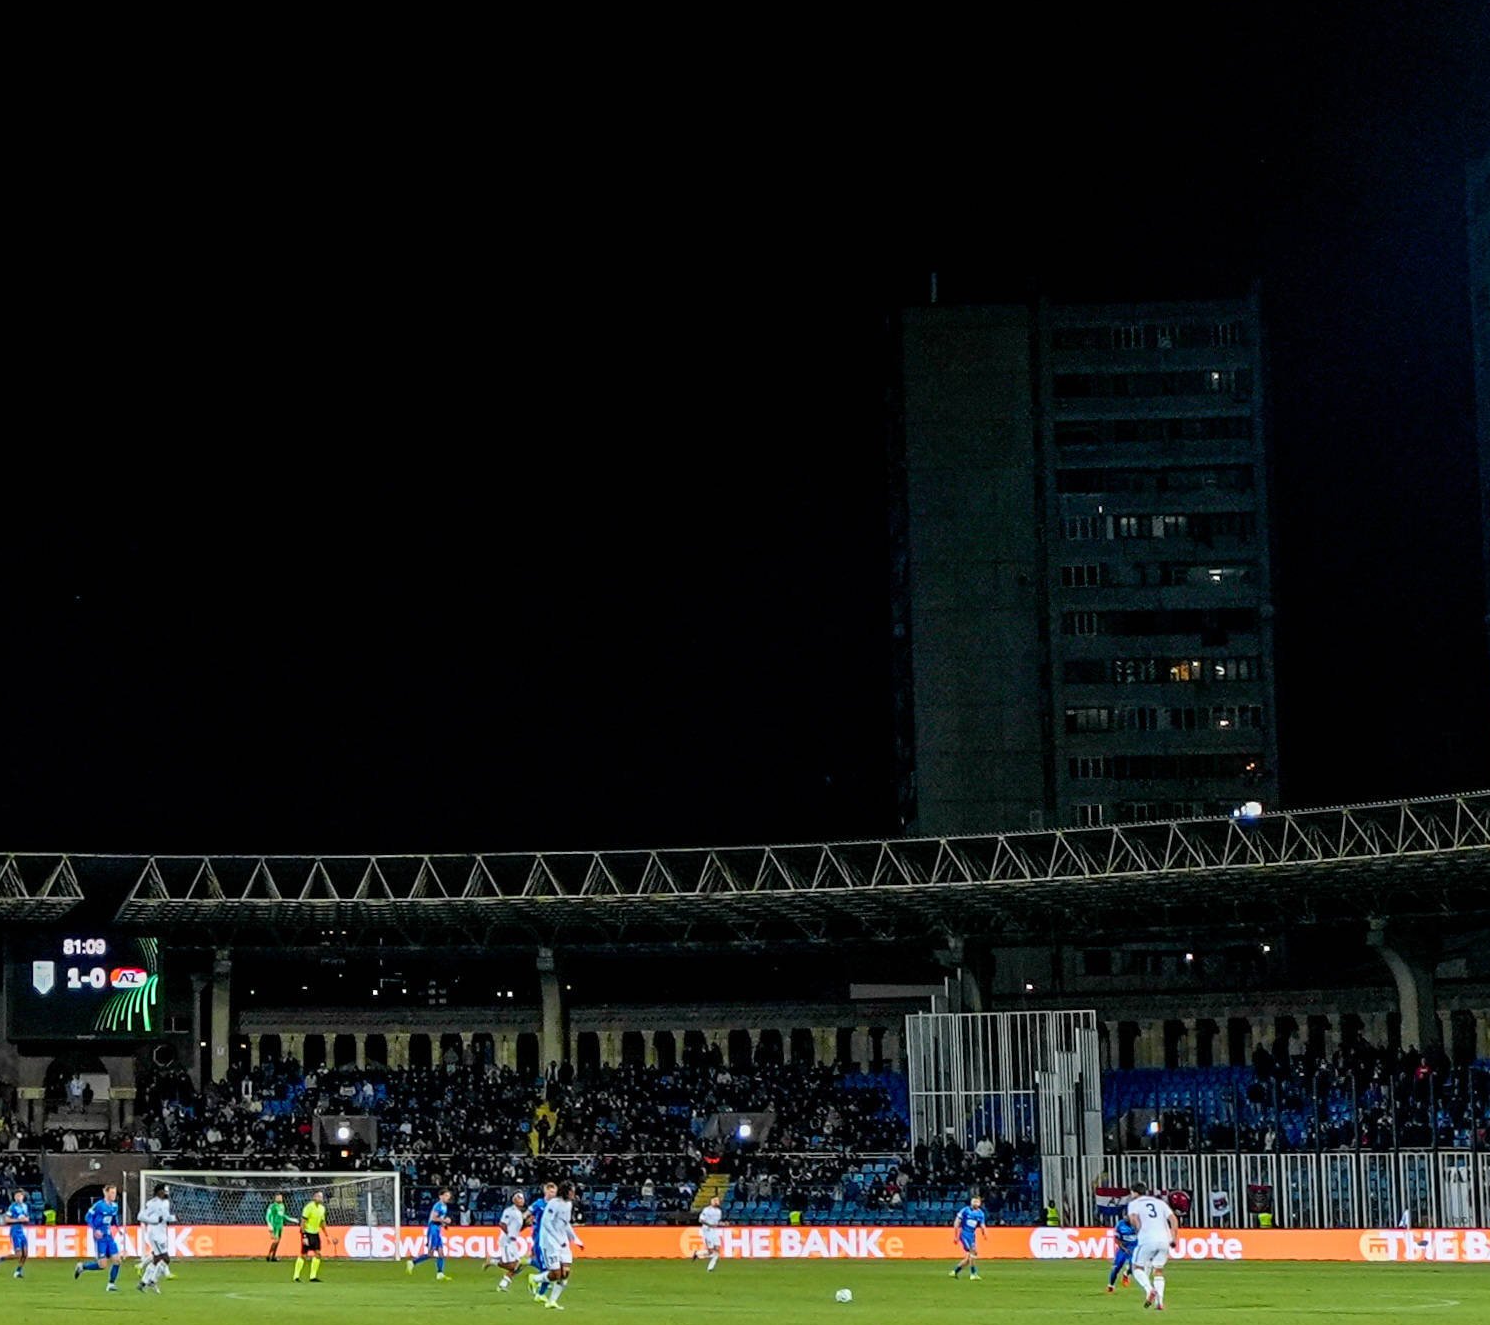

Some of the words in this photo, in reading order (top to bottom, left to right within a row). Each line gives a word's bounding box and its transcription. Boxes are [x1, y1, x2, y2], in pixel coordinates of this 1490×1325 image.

[63, 938, 106, 955] 81:09
[1145, 1202, 1158, 1219] 3
[780, 1228, 885, 1258] BANK
[1379, 1231, 1456, 1261] THE
